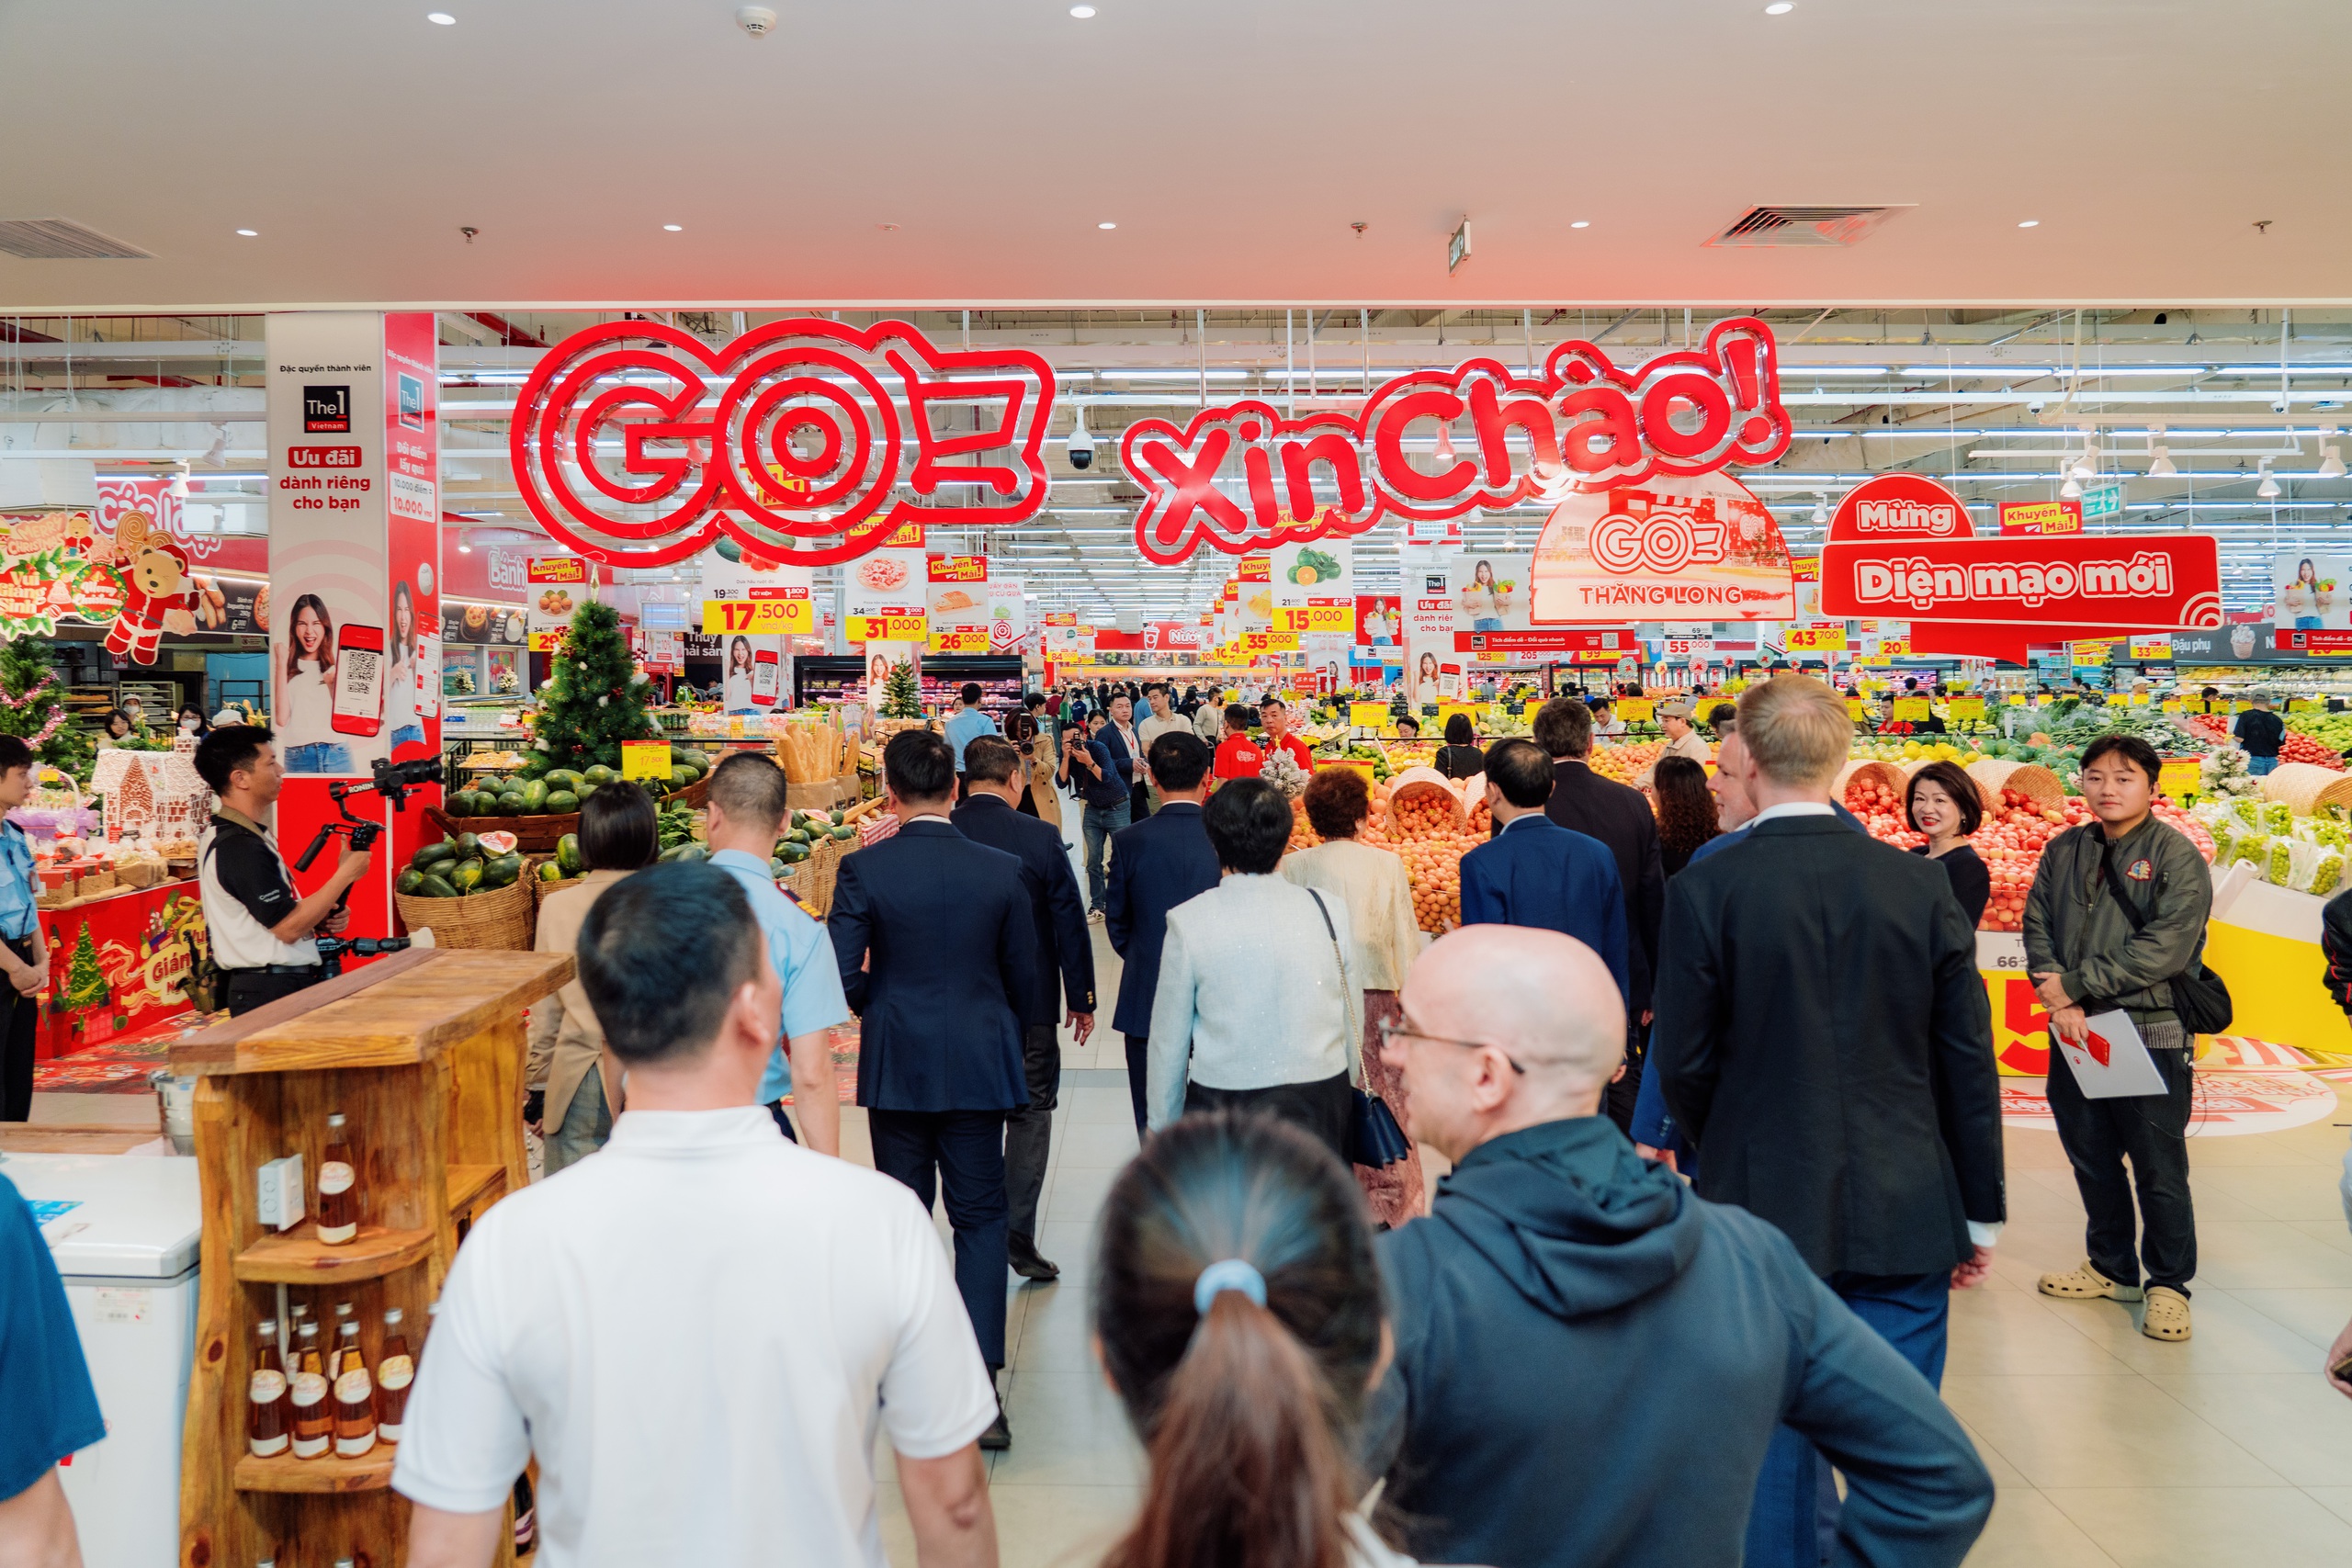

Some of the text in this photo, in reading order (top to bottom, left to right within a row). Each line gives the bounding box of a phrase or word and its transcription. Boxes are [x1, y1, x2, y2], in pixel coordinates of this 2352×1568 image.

[280, 365, 296, 374] Đặc
[327, 364, 351, 372] thành
[354, 364, 371, 372] viên
[293, 448, 356, 466] Ưu đãi
[280, 475, 370, 491] dành riêng
[293, 496, 360, 513] cho bạn
[393, 496, 423, 514] 10.000
[1860, 500, 1951, 534] Mừng
[2007, 505, 2057, 522] Khuyến
[17, 516, 65, 540] MERRY
[9, 570, 40, 586] Vui
[1859, 554, 2170, 606] Diện mạo mới
[1579, 583, 1743, 604] THĂNG LONG
[721, 603, 798, 630] 17.500
[1285, 610, 1342, 630] 15.000
[1414, 614, 1435, 622] dành
[865, 618, 921, 638] 31.000
[940, 634, 985, 649] 26.000
[1247, 634, 1293, 649] 35.000
[1669, 641, 1710, 653] 55.000
[1792, 631, 1839, 646] 43.700
[2172, 638, 2211, 653] Đậu phụ
[349, 782, 375, 794] RONIN
[153, 954, 192, 982] Gián
